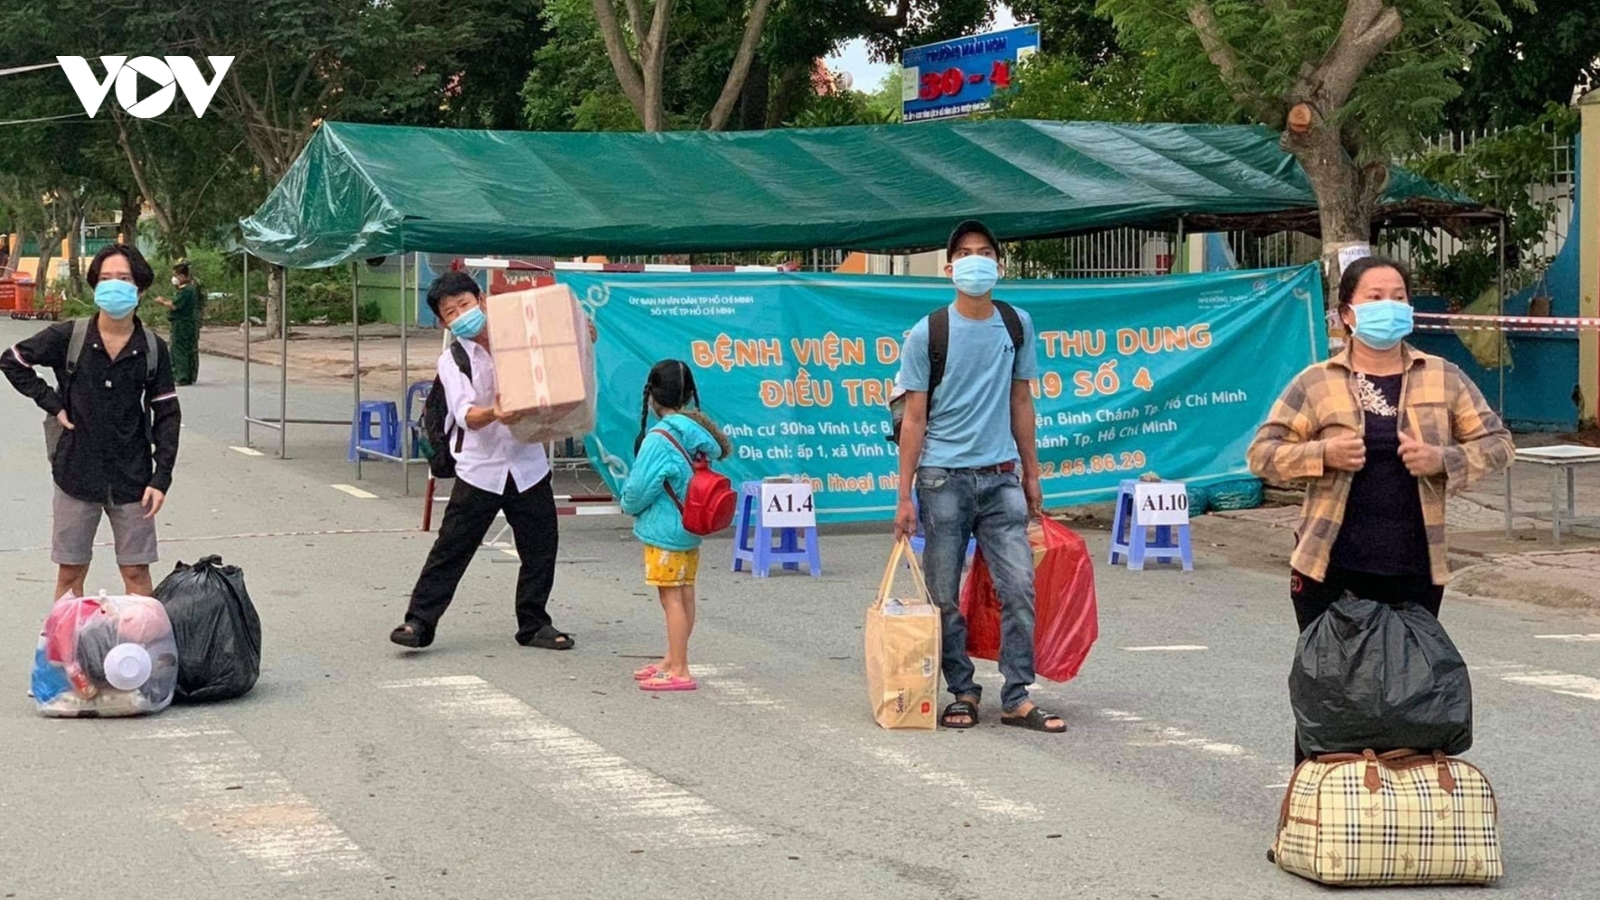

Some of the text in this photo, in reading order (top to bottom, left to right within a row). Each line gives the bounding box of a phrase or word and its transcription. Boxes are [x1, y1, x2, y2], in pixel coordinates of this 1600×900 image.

[919, 66, 963, 100] 30
[988, 60, 1011, 88] 4
[640, 297, 656, 305] BAN
[698, 296, 708, 304] TP
[734, 296, 754, 304] MINH
[679, 308, 689, 316] TP
[691, 323, 1213, 372] BỆNH VIỆN D THU DUNG
[759, 368, 833, 407] ĐIỀU
[1073, 359, 1120, 397] SỐ
[1132, 367, 1154, 391] 4
[722, 424, 753, 439] định
[757, 424, 775, 436] cư
[780, 421, 815, 435] 30ha
[818, 421, 850, 435] Vĩnh
[854, 421, 877, 437] Lộc
[1096, 408, 1139, 423] Chánh
[1144, 404, 1160, 416] Tp.
[1185, 392, 1208, 407] Chí
[1211, 388, 1247, 404] Minh
[738, 445, 763, 461] Địa
[797, 443, 812, 461] ấp
[817, 445, 828, 459] 1,
[832, 445, 847, 458] xã
[851, 443, 884, 457] Vĩnh
[1073, 433, 1093, 448] Tp.
[1098, 427, 1115, 443] Hồ
[1119, 425, 1139, 439] Chí
[1142, 419, 1177, 434] Minh
[826, 472, 875, 494] thoại
[767, 494, 813, 512] A1.4
[1142, 494, 1187, 511] A1.10
